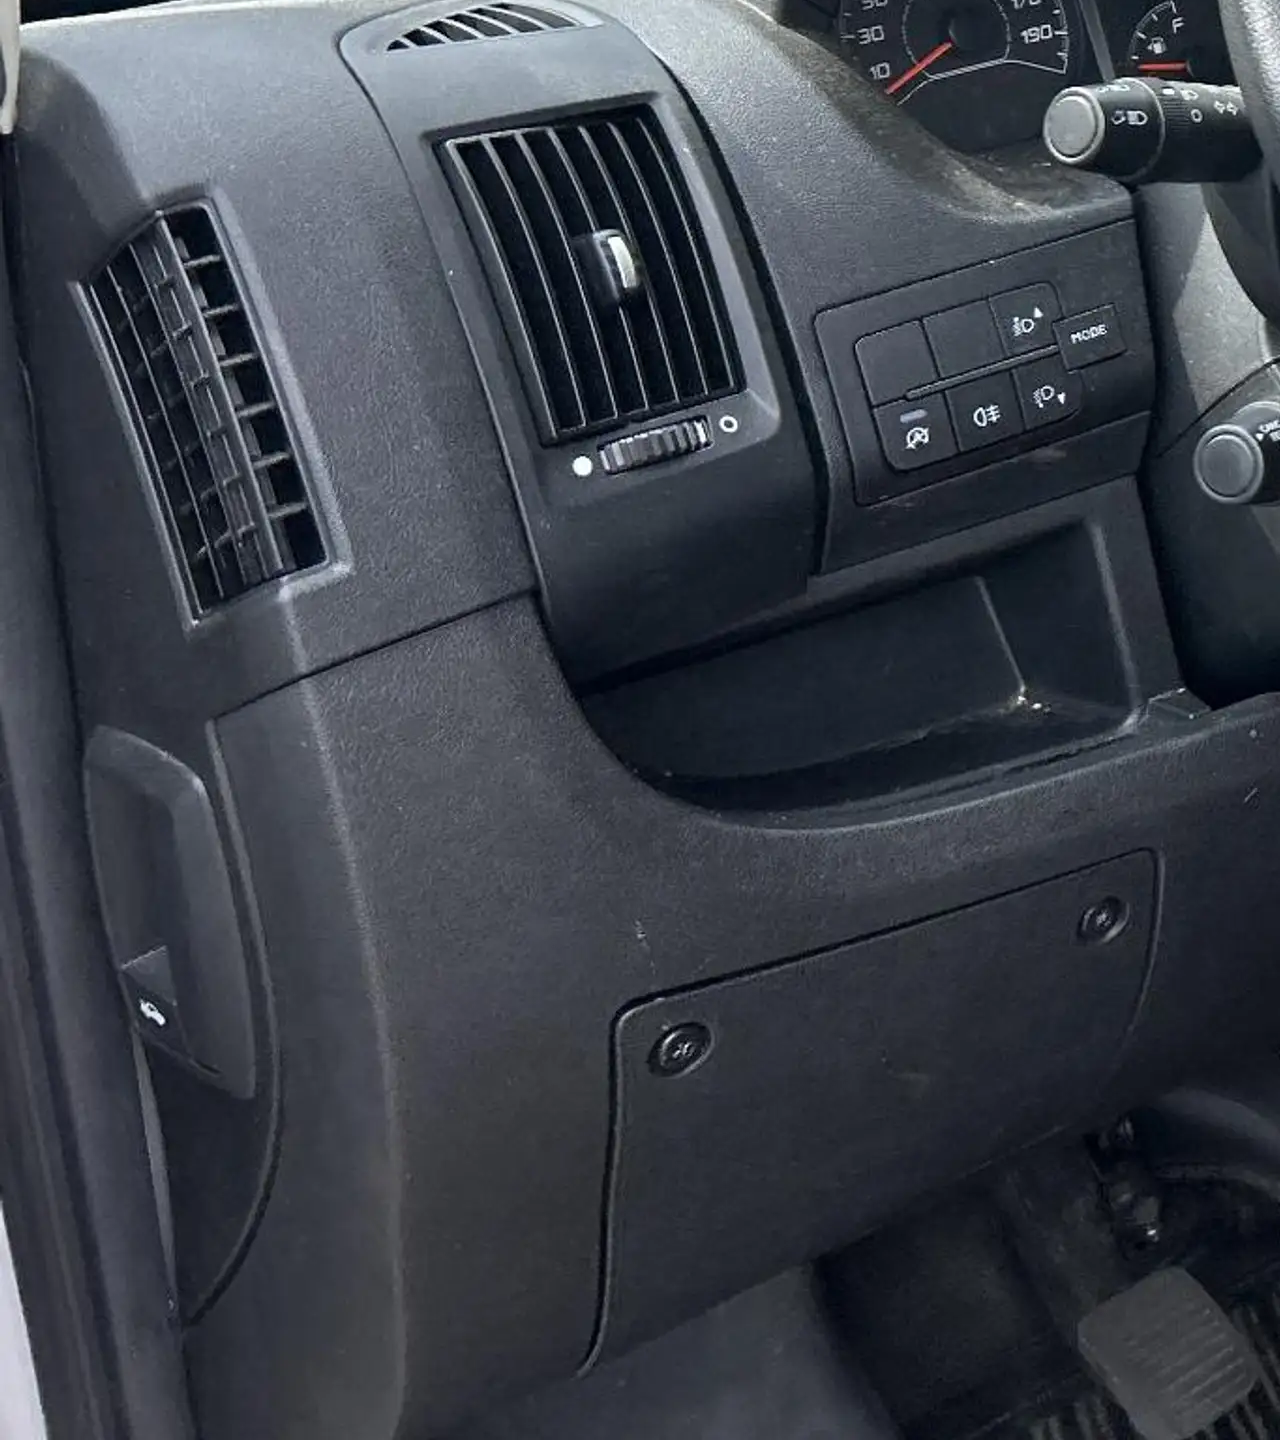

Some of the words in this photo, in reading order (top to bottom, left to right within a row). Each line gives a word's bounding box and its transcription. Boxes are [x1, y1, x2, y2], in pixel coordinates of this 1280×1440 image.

[1020, 24, 1053, 44] 190
[1171, 16, 1185, 34] F
[858, 25, 885, 45] 30
[869, 62, 890, 80] 10
[1071, 324, 1107, 343] MODE
